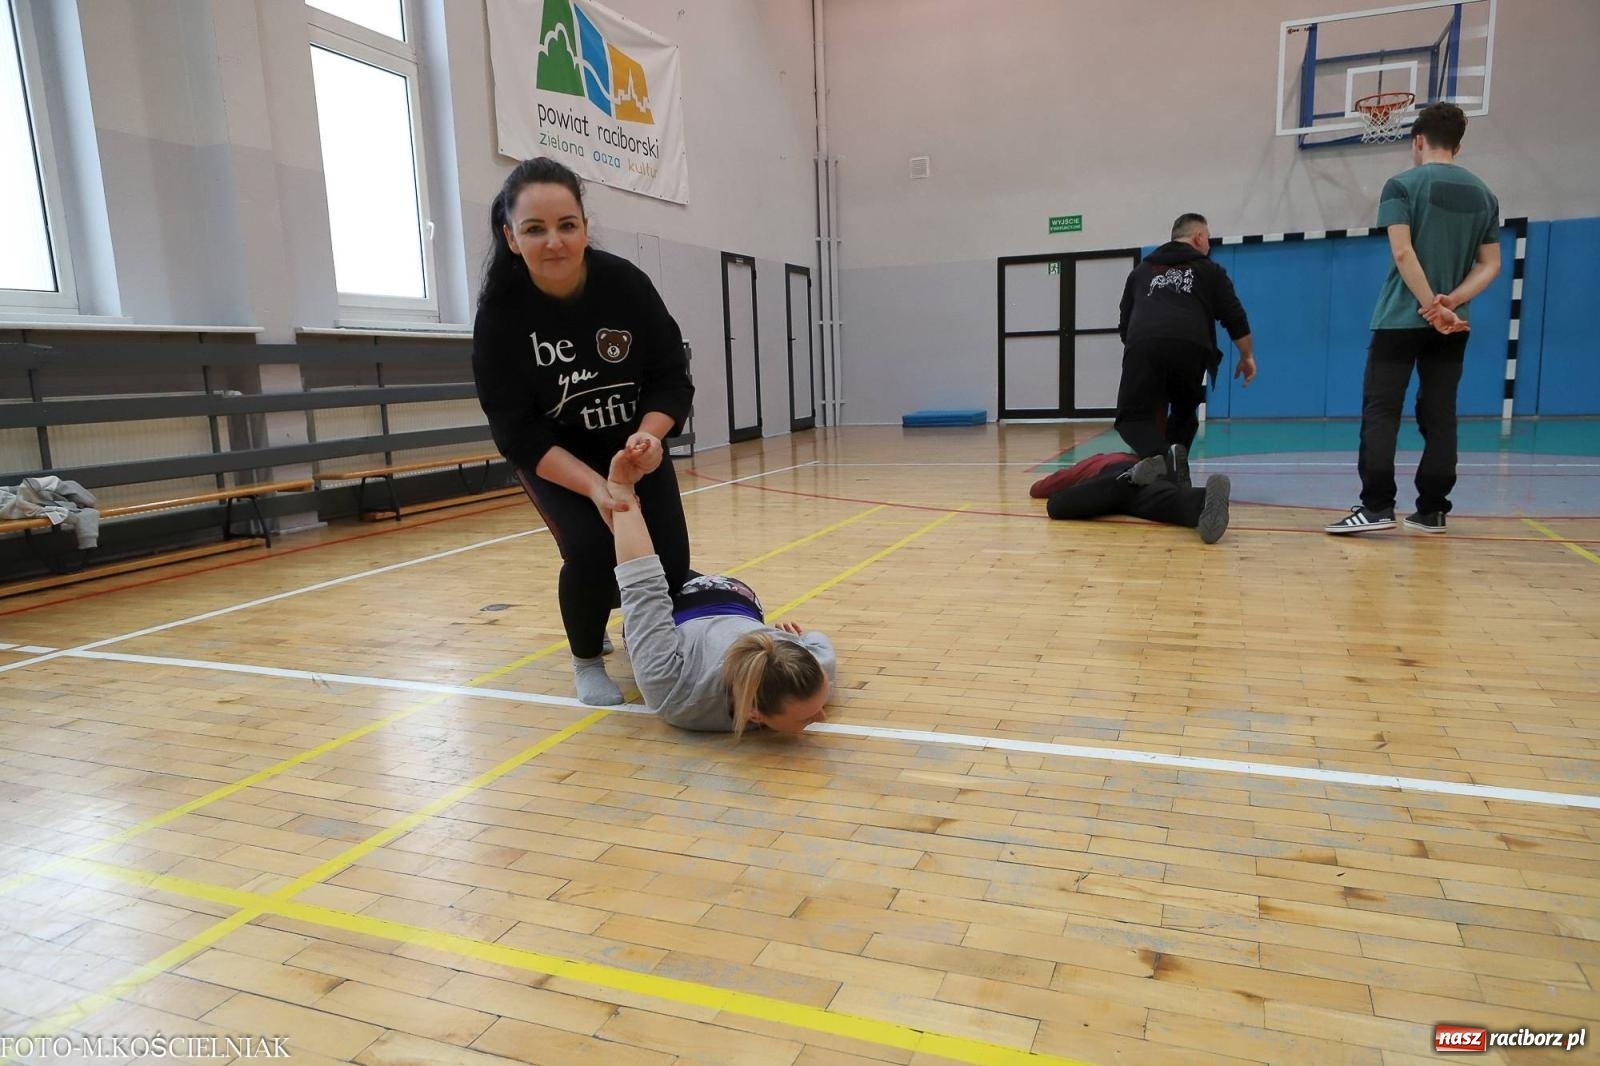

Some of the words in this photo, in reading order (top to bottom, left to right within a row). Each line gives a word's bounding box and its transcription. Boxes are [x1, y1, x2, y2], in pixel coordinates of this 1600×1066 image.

[537, 103, 590, 137] powiat
[597, 125, 660, 159] raciborski
[539, 131, 585, 157] zielona
[592, 150, 621, 168] oaza
[529, 331, 577, 367] be
[551, 368, 599, 418] you
[580, 388, 641, 430] tifu
